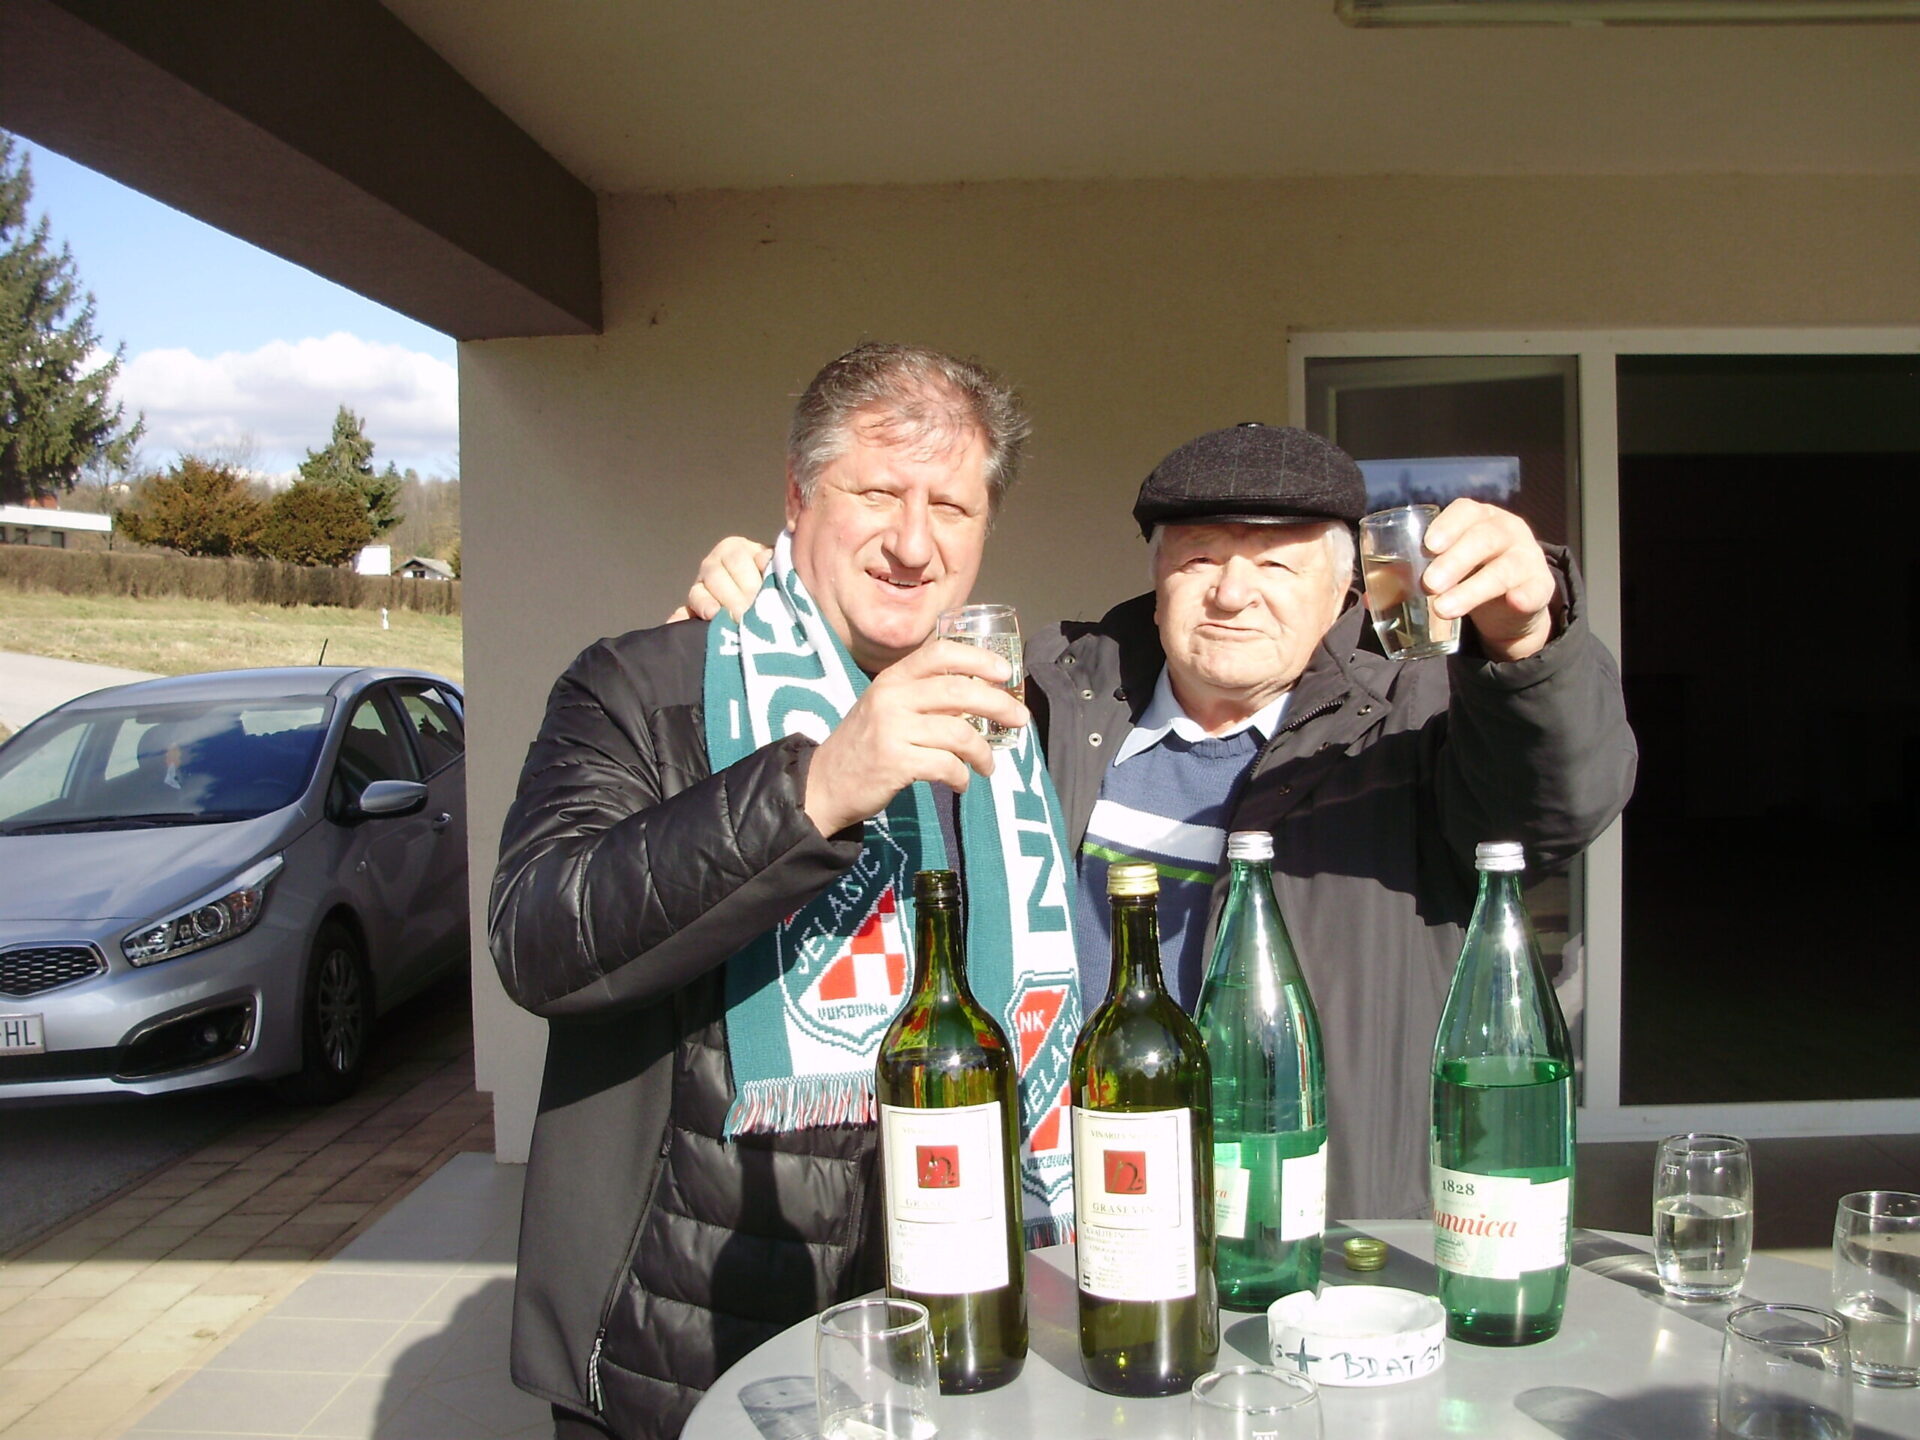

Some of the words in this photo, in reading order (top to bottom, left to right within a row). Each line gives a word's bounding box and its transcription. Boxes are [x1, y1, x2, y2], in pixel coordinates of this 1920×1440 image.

[817, 1003, 888, 1020] VUKOVINA
[1019, 1010, 1046, 1033] NK
[1026, 1153, 1072, 1170] VUKOVIN
[1441, 1179, 1475, 1197] 1828
